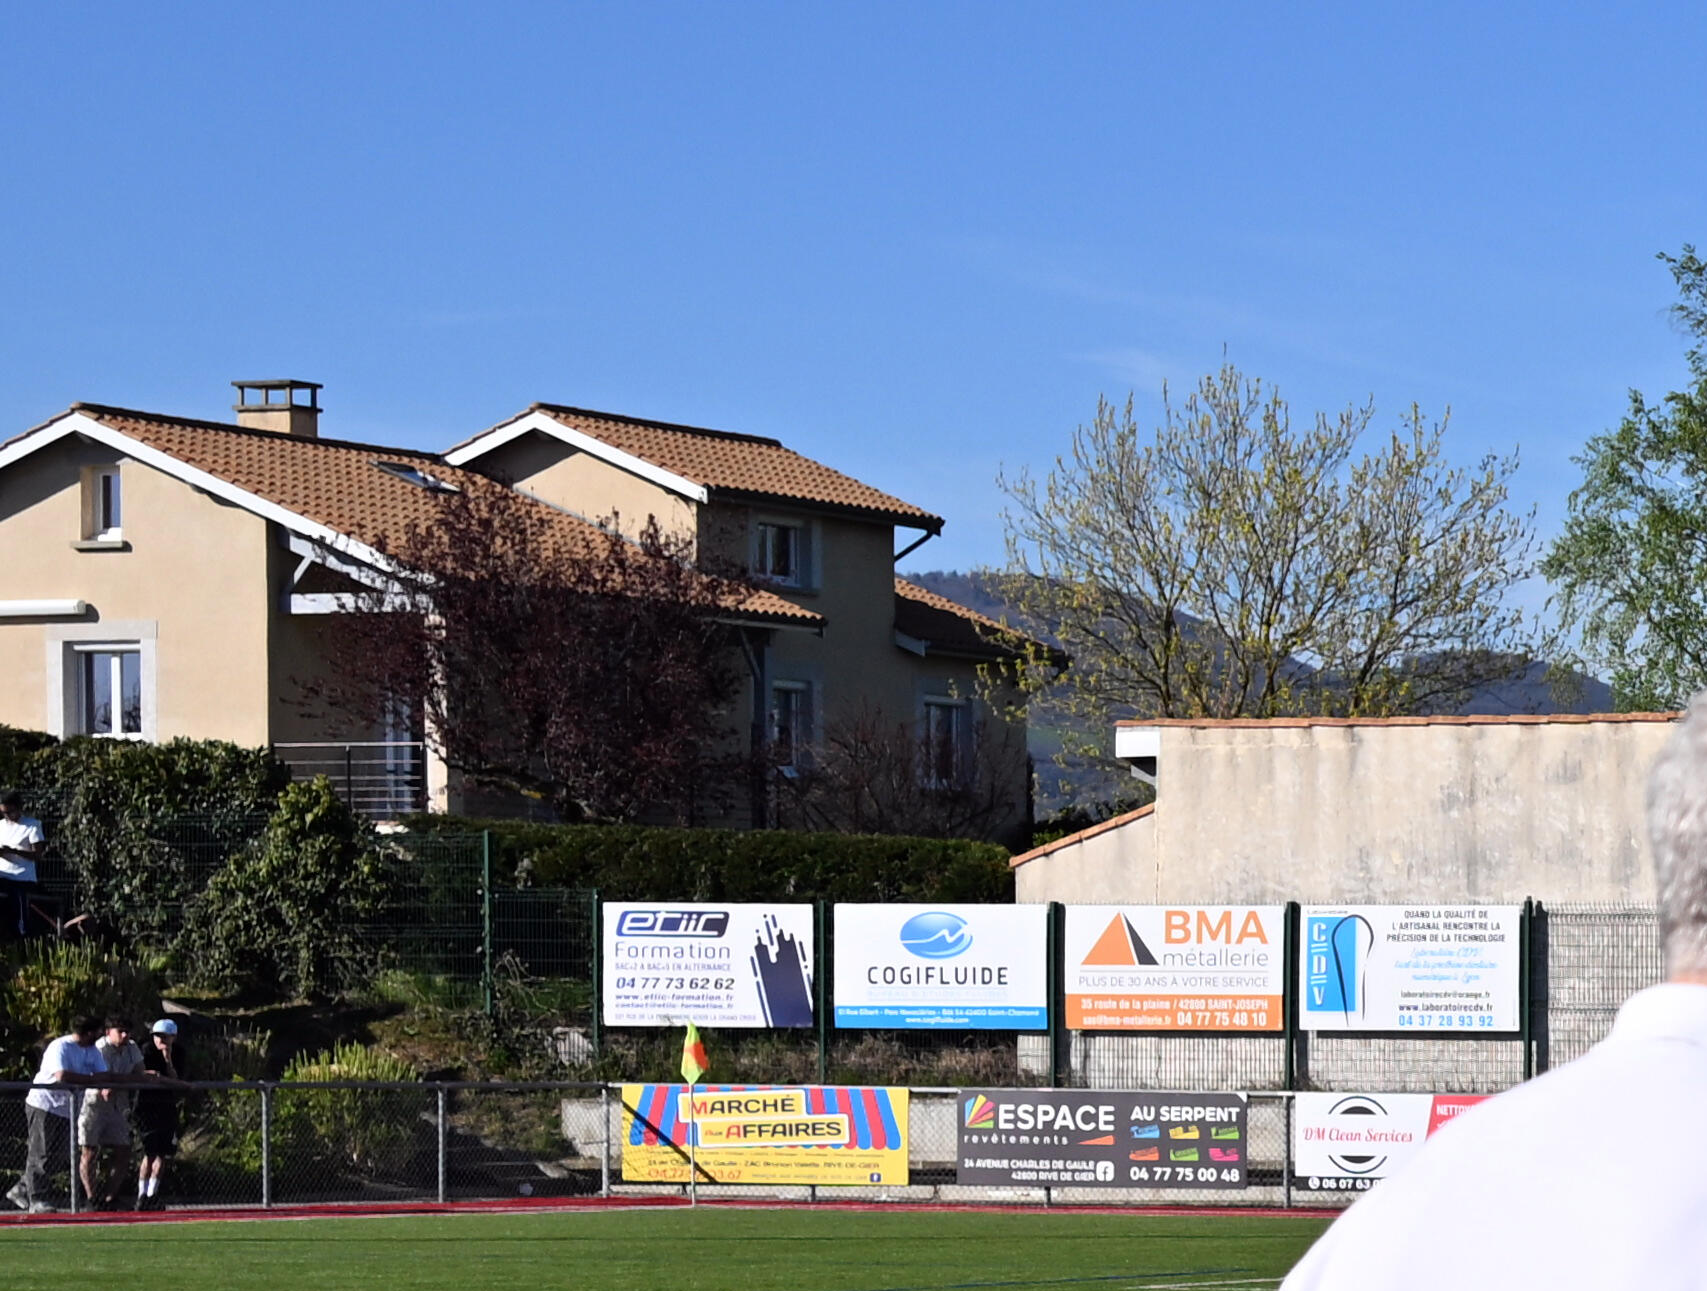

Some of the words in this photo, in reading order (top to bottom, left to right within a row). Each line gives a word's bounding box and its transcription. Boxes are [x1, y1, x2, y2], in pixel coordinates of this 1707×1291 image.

[1444, 908, 1475, 919] QUALITÉ
[1165, 911, 1268, 944] BMA
[1443, 922, 1488, 930] RENCONTRE
[616, 942, 730, 959] Formation
[1163, 949, 1268, 966] métallerie
[868, 967, 1008, 985] COGIFLUIDE
[1079, 976, 1106, 986] PLUS
[1111, 977, 1124, 986] DE
[1128, 977, 1140, 986] 30
[1144, 977, 1167, 986] ANS
[1182, 977, 1218, 987] VOTRE
[1222, 977, 1268, 987] SERVICE
[616, 978, 636, 989] 04
[642, 978, 661, 989] 77
[665, 978, 685, 990] 73
[689, 978, 710, 990] 62
[714, 978, 735, 990] 62
[1082, 998, 1092, 1009] 35
[1207, 999, 1268, 1010] SAINT-JOSEPH
[1177, 1012, 1192, 1026] 04
[1196, 1012, 1211, 1026] 77
[1215, 1012, 1229, 1026] 75
[1233, 1012, 1248, 1026] 48
[1252, 1012, 1266, 1026] 10
[1399, 1016, 1413, 1026] 04
[1419, 1016, 1432, 1026] 37
[1439, 1016, 1453, 1026] 28
[1459, 1016, 1473, 1026] 93
[1479, 1016, 1493, 1027] 92
[691, 1095, 796, 1114] MARCHÉ
[998, 1104, 1115, 1131] ESPACE
[1130, 1106, 1155, 1121] AU
[1159, 1106, 1240, 1122] SERPENT
[726, 1121, 842, 1138] AFFAIRES
[1329, 1127, 1361, 1141] Clean
[1365, 1128, 1413, 1143] Services
[964, 1133, 1068, 1145] revêtements
[976, 1159, 1009, 1168] AVENUE
[1011, 1160, 1050, 1169] CHARLES
[1051, 1160, 1064, 1169] DE
[1039, 1171, 1056, 1180] RIVE
[1058, 1172, 1071, 1181] DE
[1130, 1167, 1149, 1180] 04
[1153, 1167, 1172, 1181] 77
[1175, 1167, 1194, 1181] 75
[1198, 1168, 1217, 1182] 00
[1220, 1168, 1240, 1182] 48
[1322, 1179, 1337, 1189] 06
[1339, 1179, 1353, 1189] 07
[1356, 1179, 1370, 1189] 63
